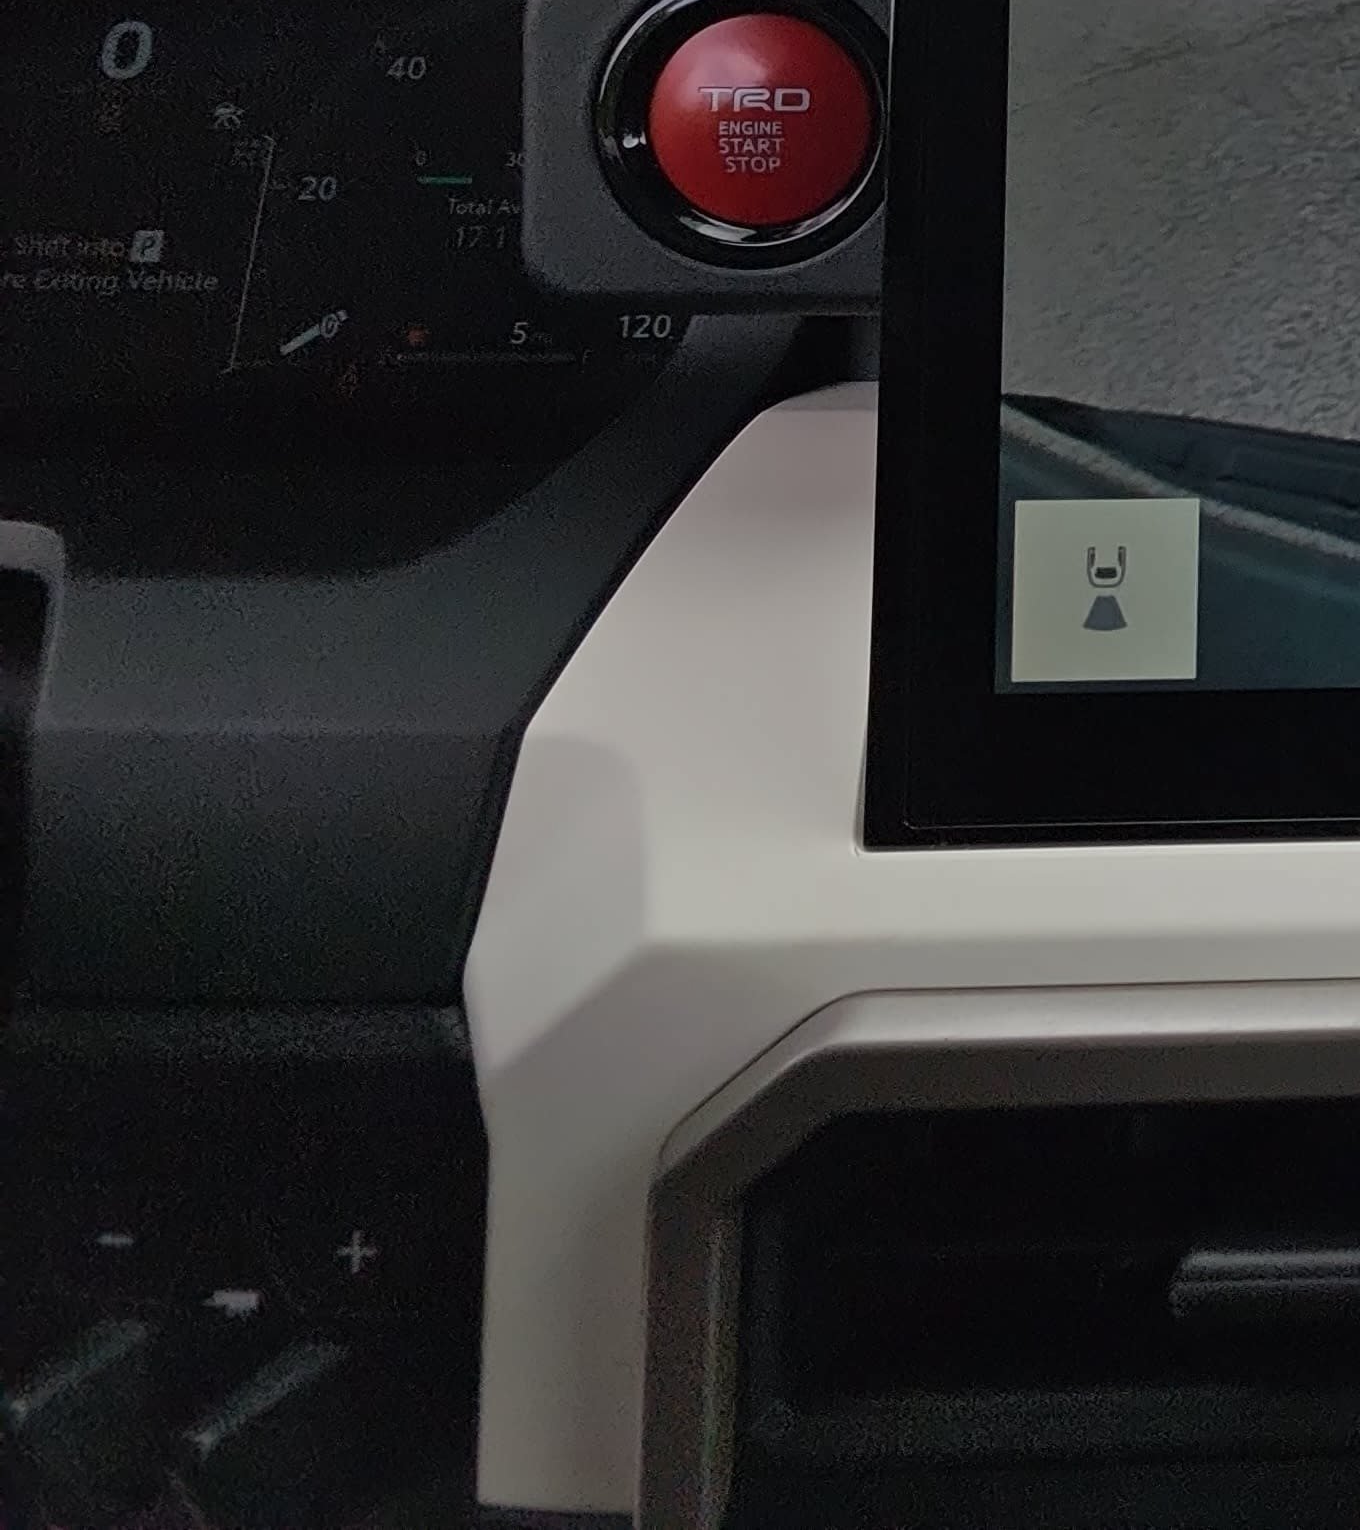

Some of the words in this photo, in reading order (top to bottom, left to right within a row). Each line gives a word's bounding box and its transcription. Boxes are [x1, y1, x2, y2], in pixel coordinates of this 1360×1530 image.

[100, 19, 154, 81] 0
[386, 55, 428, 82] 40
[698, 86, 811, 113] TRD
[718, 120, 783, 136] ENGINE
[718, 137, 785, 155] START
[725, 155, 782, 174] STOP
[297, 174, 340, 202] 20
[125, 267, 219, 292] Vehicle
[509, 320, 530, 346] 5
[619, 313, 672, 339] 120
